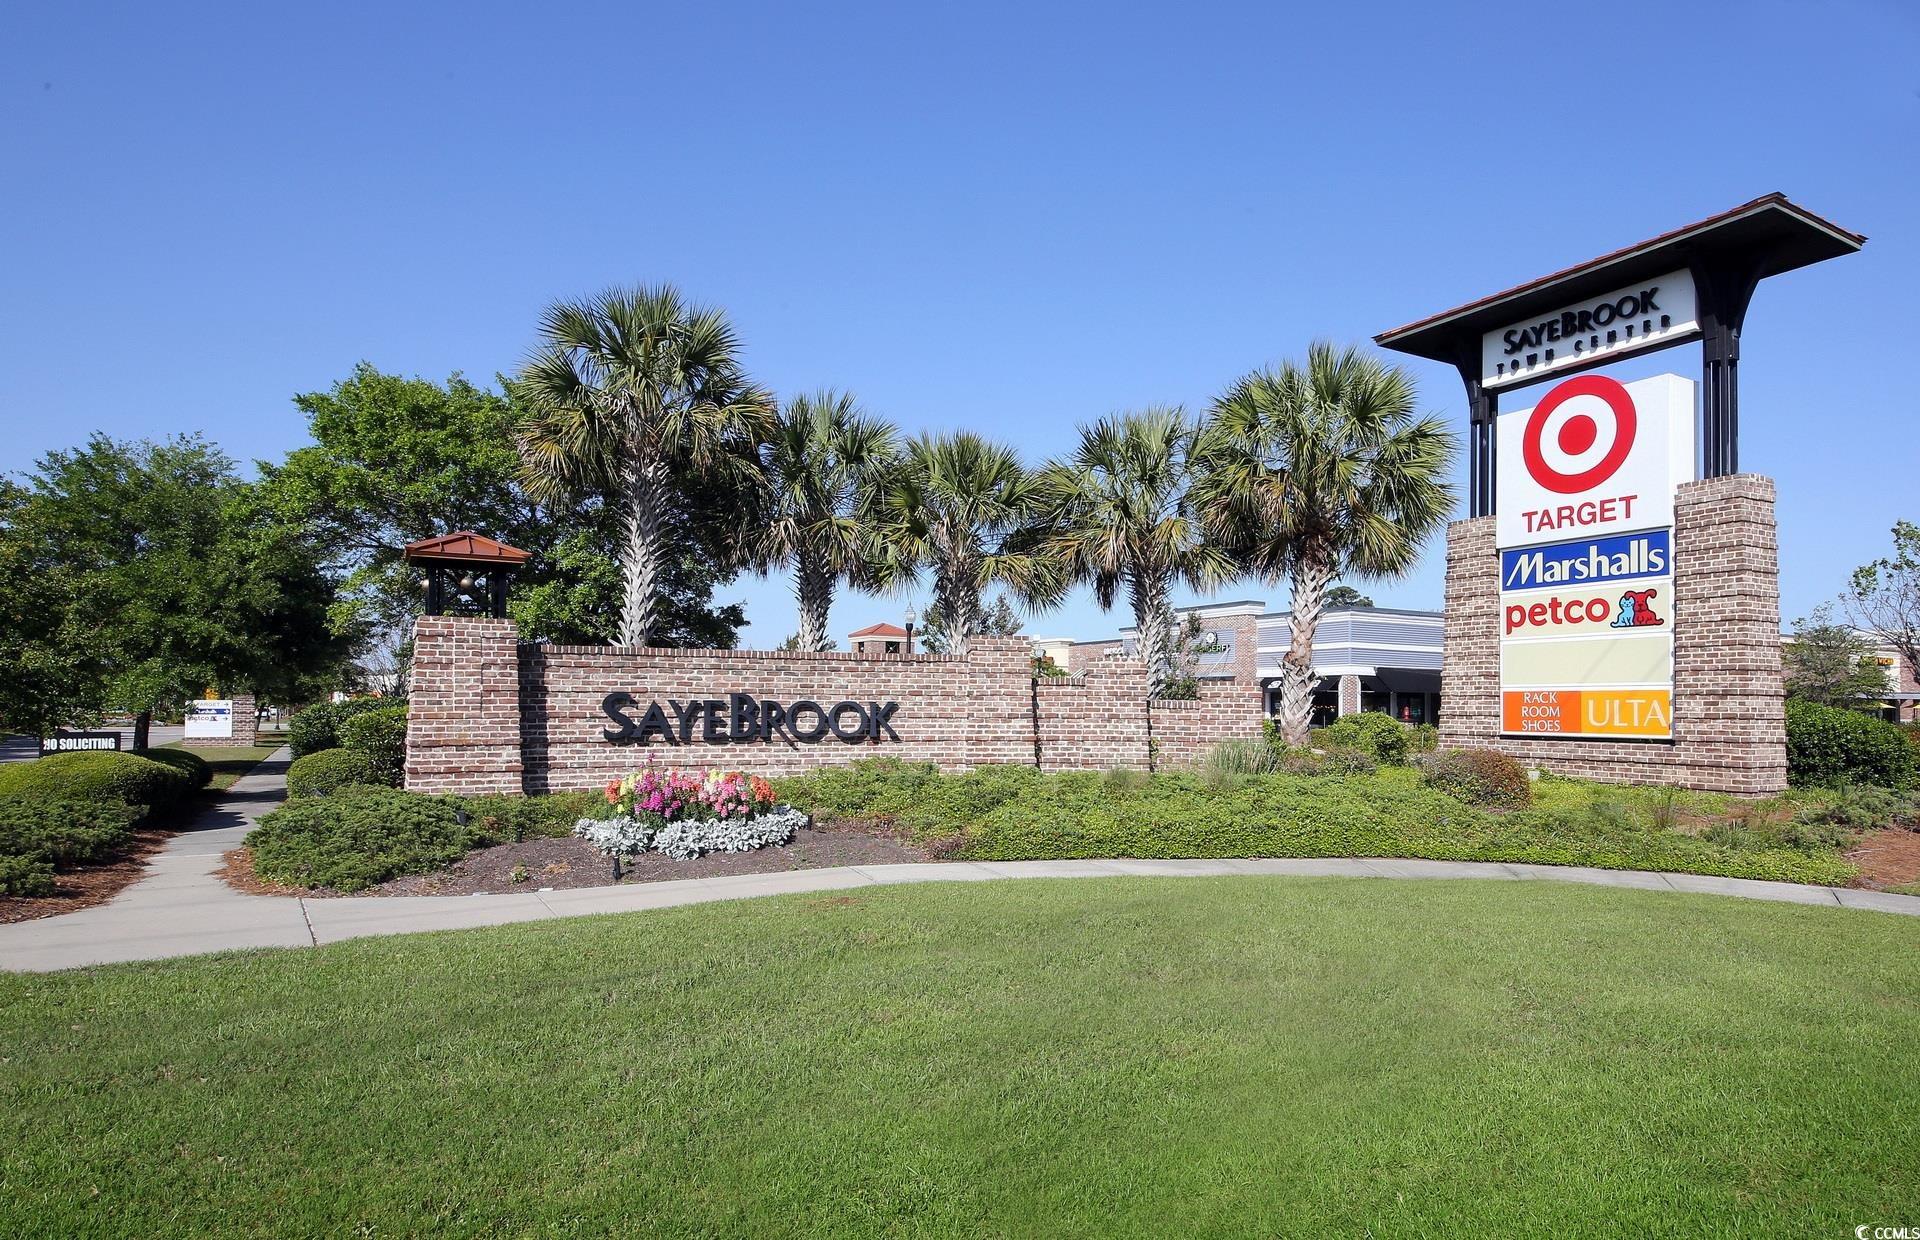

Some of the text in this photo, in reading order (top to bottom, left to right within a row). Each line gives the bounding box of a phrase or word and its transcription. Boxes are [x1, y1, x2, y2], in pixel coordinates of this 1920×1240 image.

[1503, 286, 1660, 354] SAYEBROOK
[1497, 315, 1671, 375] TOWN CENTER
[1521, 494, 1638, 533] TARGET
[1506, 538, 1665, 586] Marshalls
[1506, 597, 1611, 635] petco
[1521, 705, 1560, 718] ROOM
[1523, 691, 1558, 704] RACK
[1588, 699, 1667, 728] ULTA
[601, 691, 901, 750] SAYEBROOK
[1521, 719, 1561, 732] SHOES
[59, 737, 116, 750] SOLICITING
